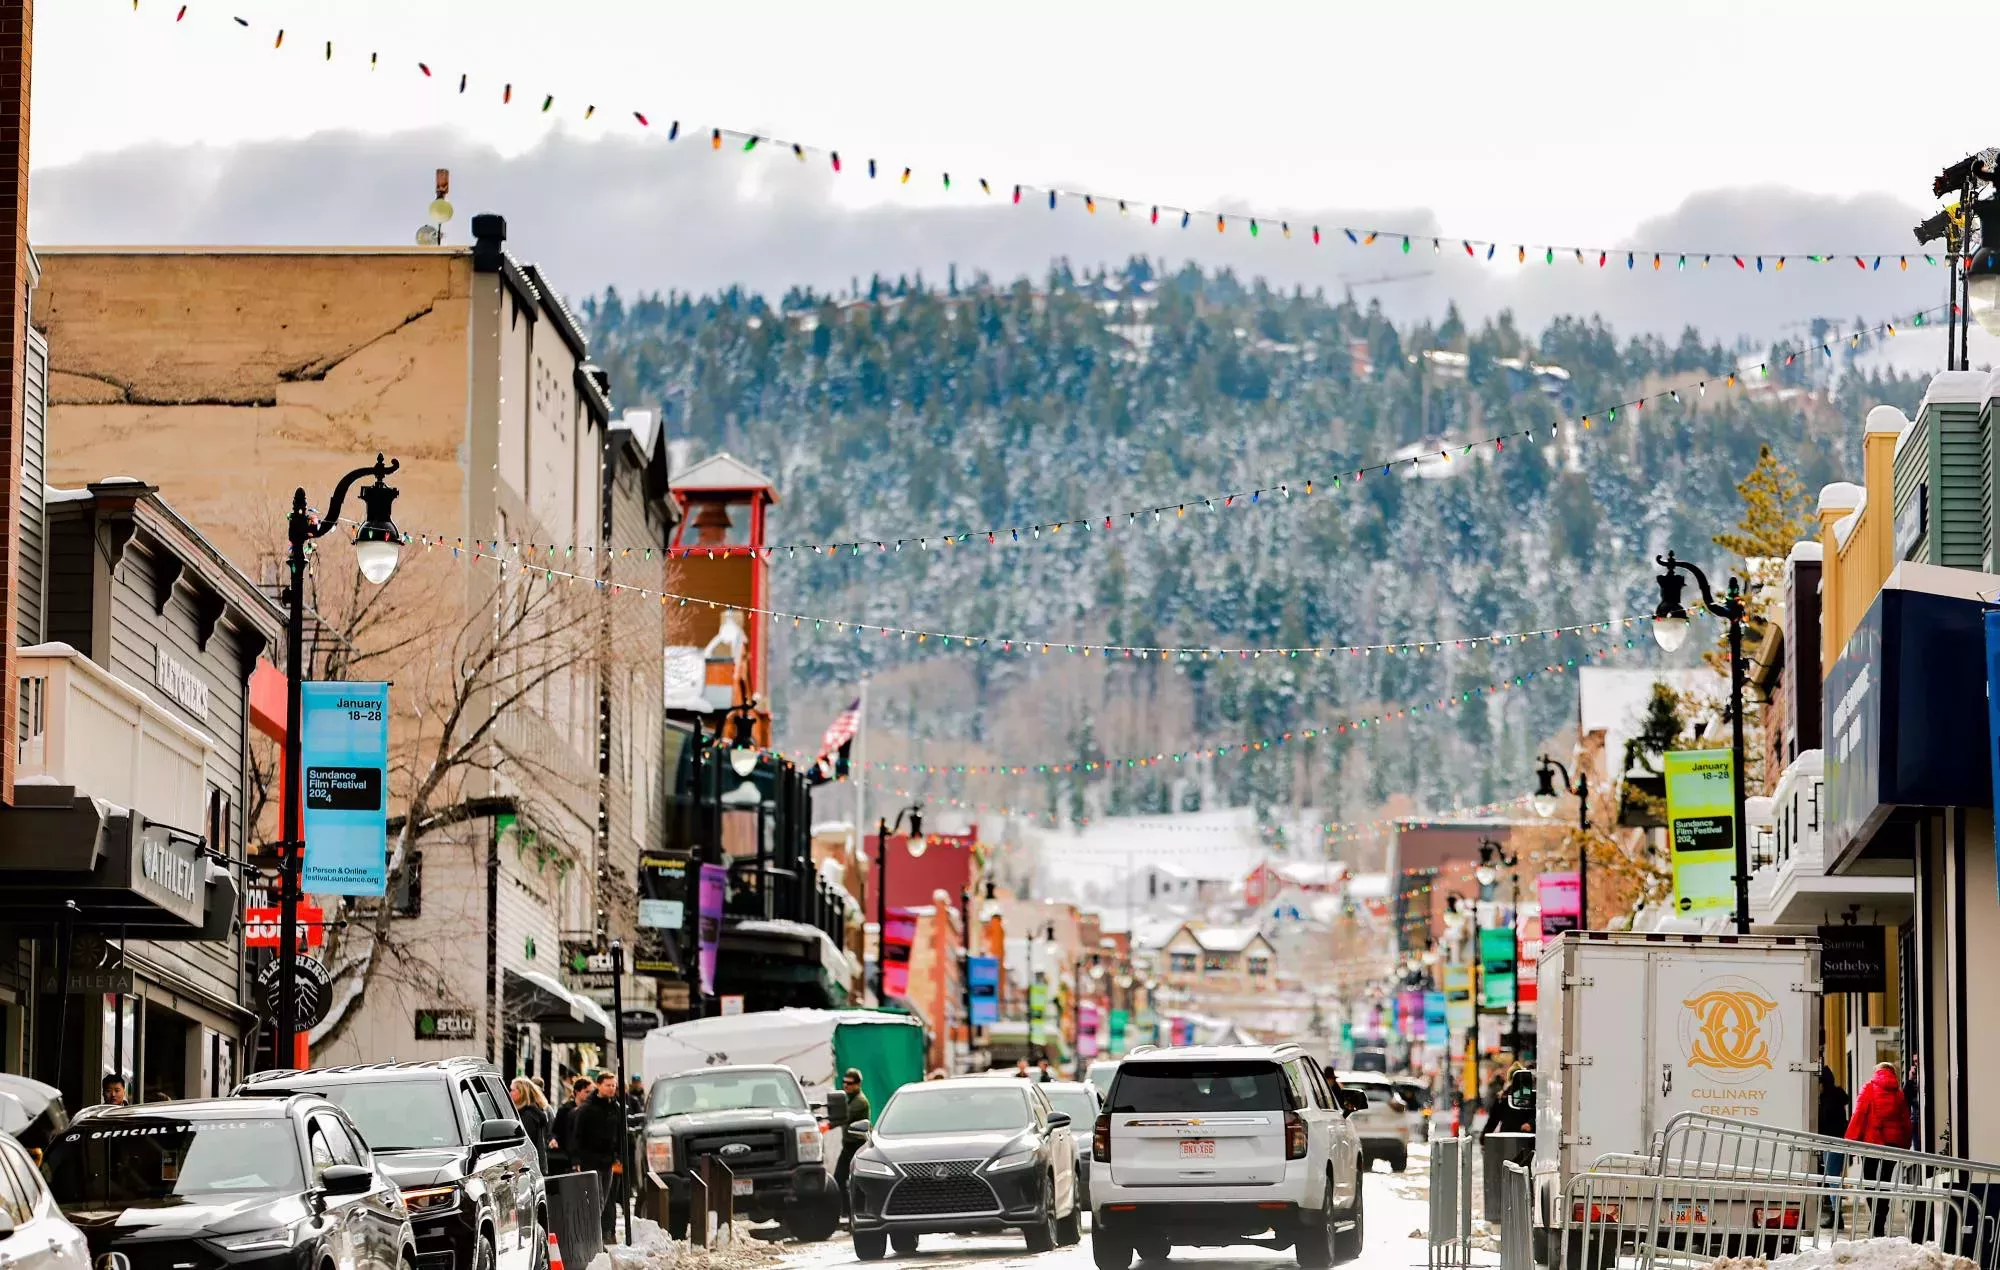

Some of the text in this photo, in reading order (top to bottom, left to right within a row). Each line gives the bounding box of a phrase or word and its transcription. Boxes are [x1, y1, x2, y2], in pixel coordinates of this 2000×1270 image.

[336, 698, 382, 710] January
[1691, 762, 1729, 772] January
[309, 770, 356, 780] Sundance
[309, 780, 367, 789] Film Festival
[309, 789, 332, 803] 2024
[1675, 820, 1714, 828] Sundance
[1676, 826, 1722, 836] Film Festival
[1676, 835, 1696, 846] 2024
[150, 841, 196, 905] ATHLETA
[344, 867, 367, 875] Online
[305, 874, 379, 884] festival.sundance.org
[1824, 959, 1879, 974] Sotheby's
[47, 975, 129, 989] AHLETA
[1691, 1088, 1768, 1100] CULINARY
[1700, 1105, 1760, 1117] CRAFTS
[91, 1121, 248, 1140] OFFICIAL VEHICLE
